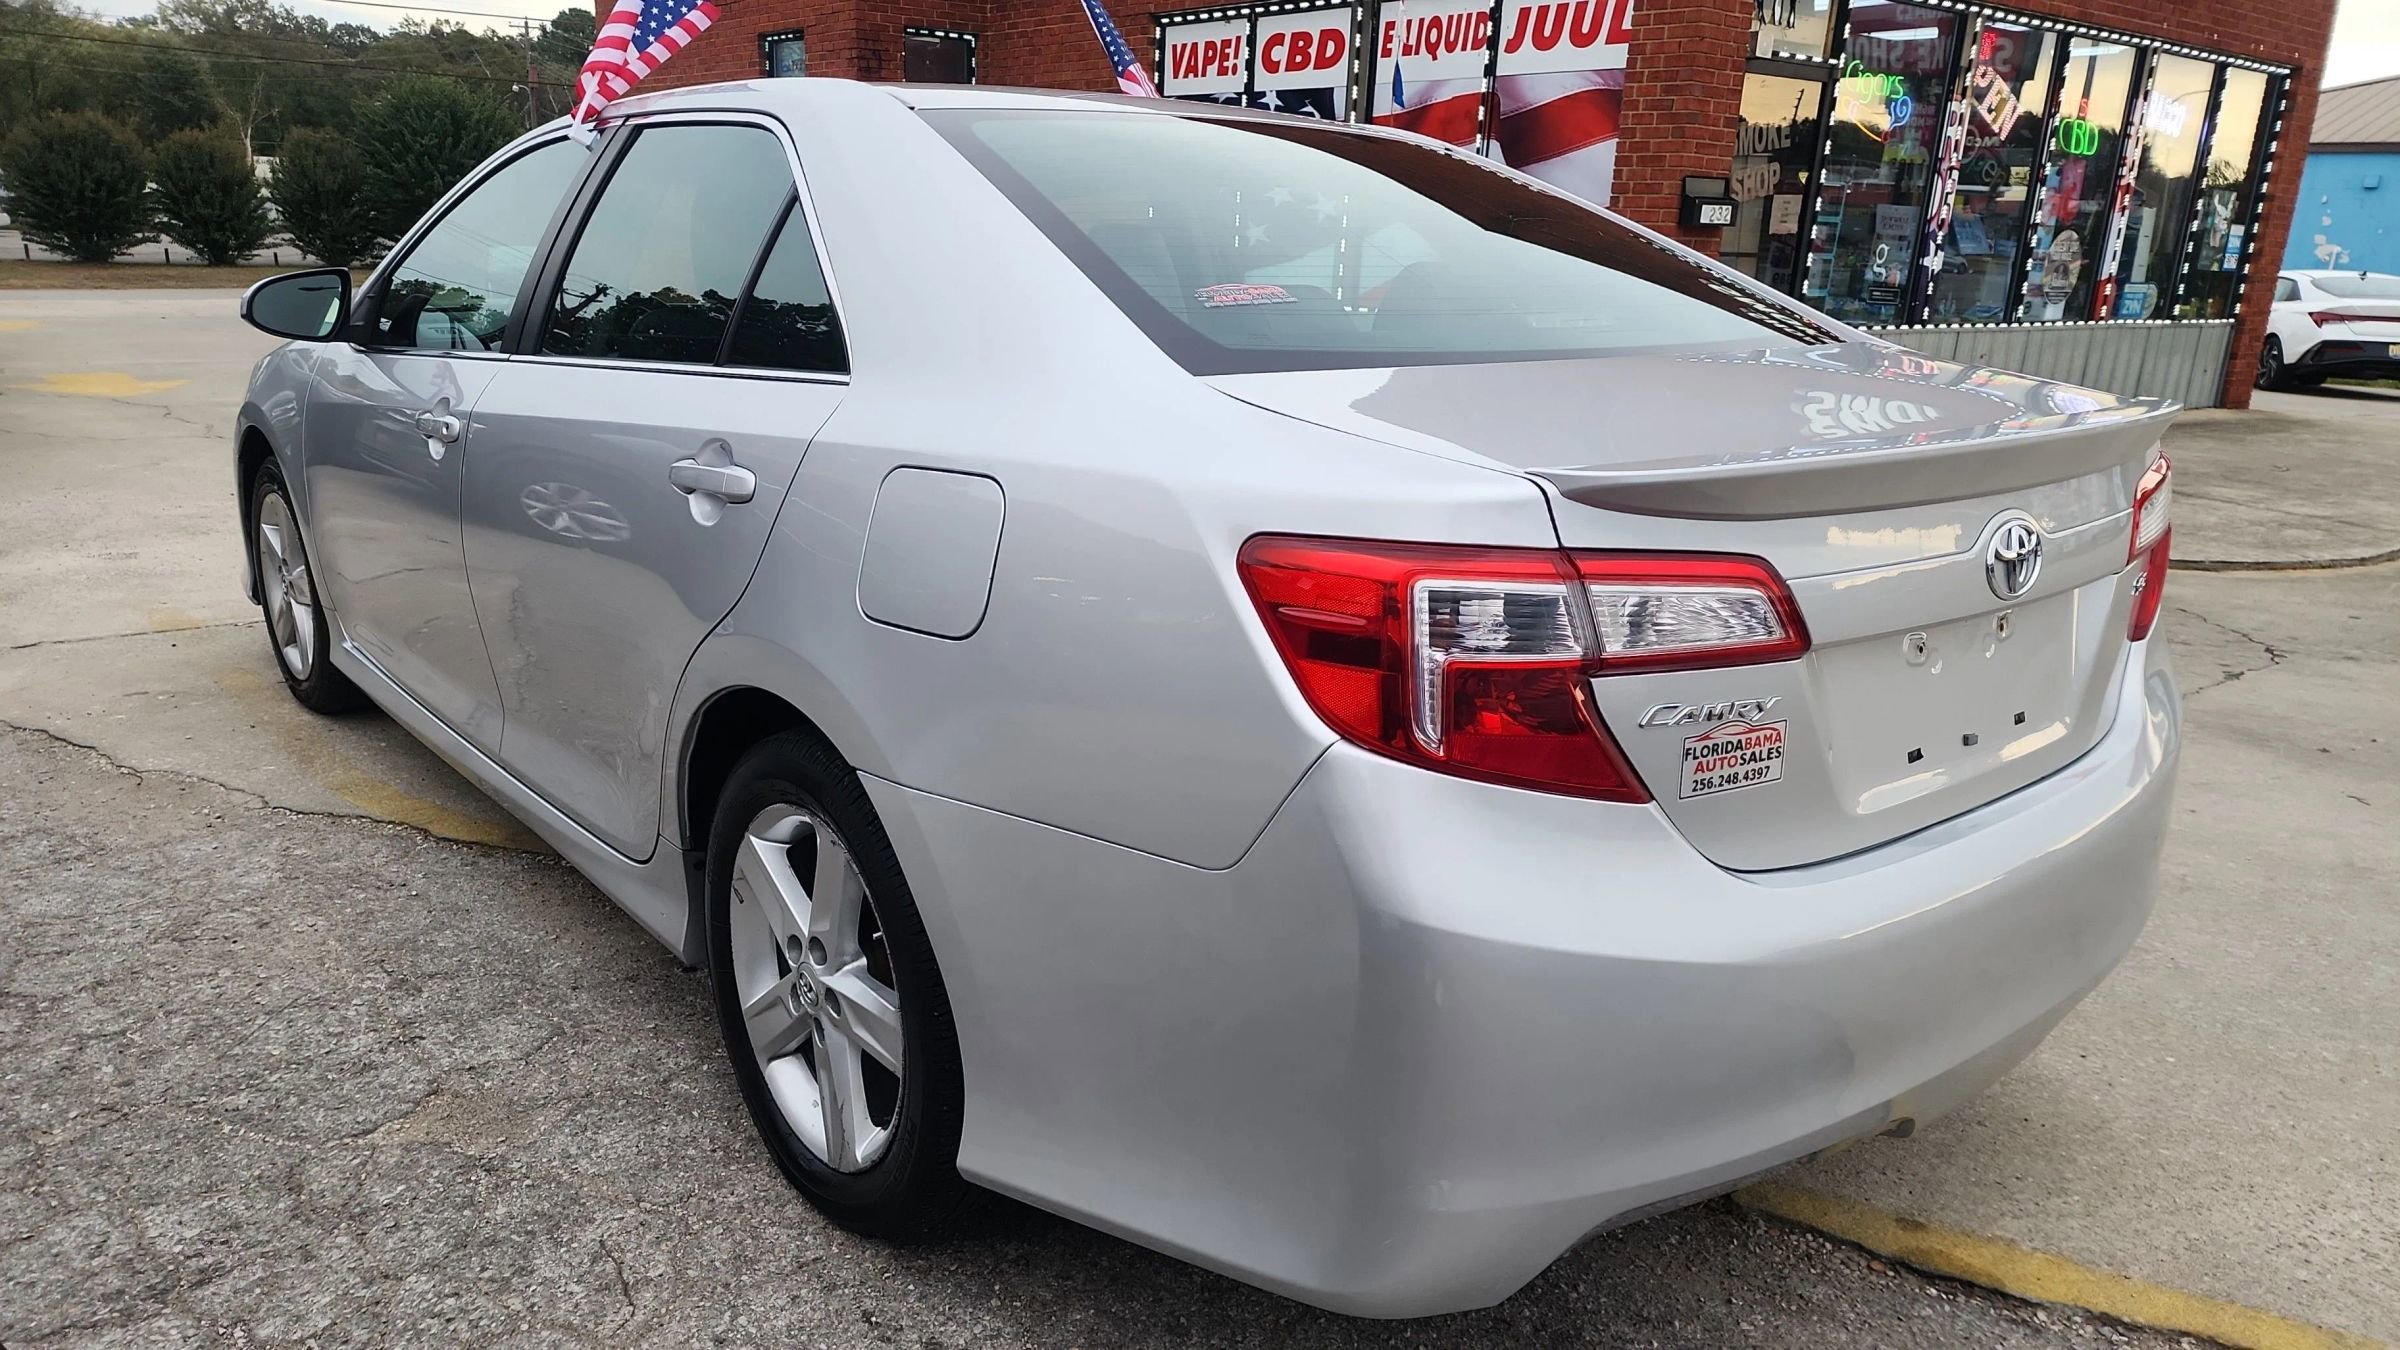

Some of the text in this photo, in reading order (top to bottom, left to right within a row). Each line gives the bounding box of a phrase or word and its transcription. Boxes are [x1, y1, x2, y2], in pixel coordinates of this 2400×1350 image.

[1261, 28, 1346, 74] CBD
[1380, 11, 1489, 61] E LIQUID
[1171, 36, 1242, 79] VAPE!
[1845, 60, 1905, 104] Cigars
[1735, 123, 1792, 157] MOKE
[2059, 118, 2098, 155] CBD
[1731, 161, 1781, 202] SHOP
[1709, 206, 1731, 223] 232
[1639, 695, 1783, 728] CAMRY
[1684, 731, 1783, 762] FLORIDABAMA
[1693, 745, 1782, 776] AUTOSALES
[1691, 765, 1771, 792] 256.248.4397
